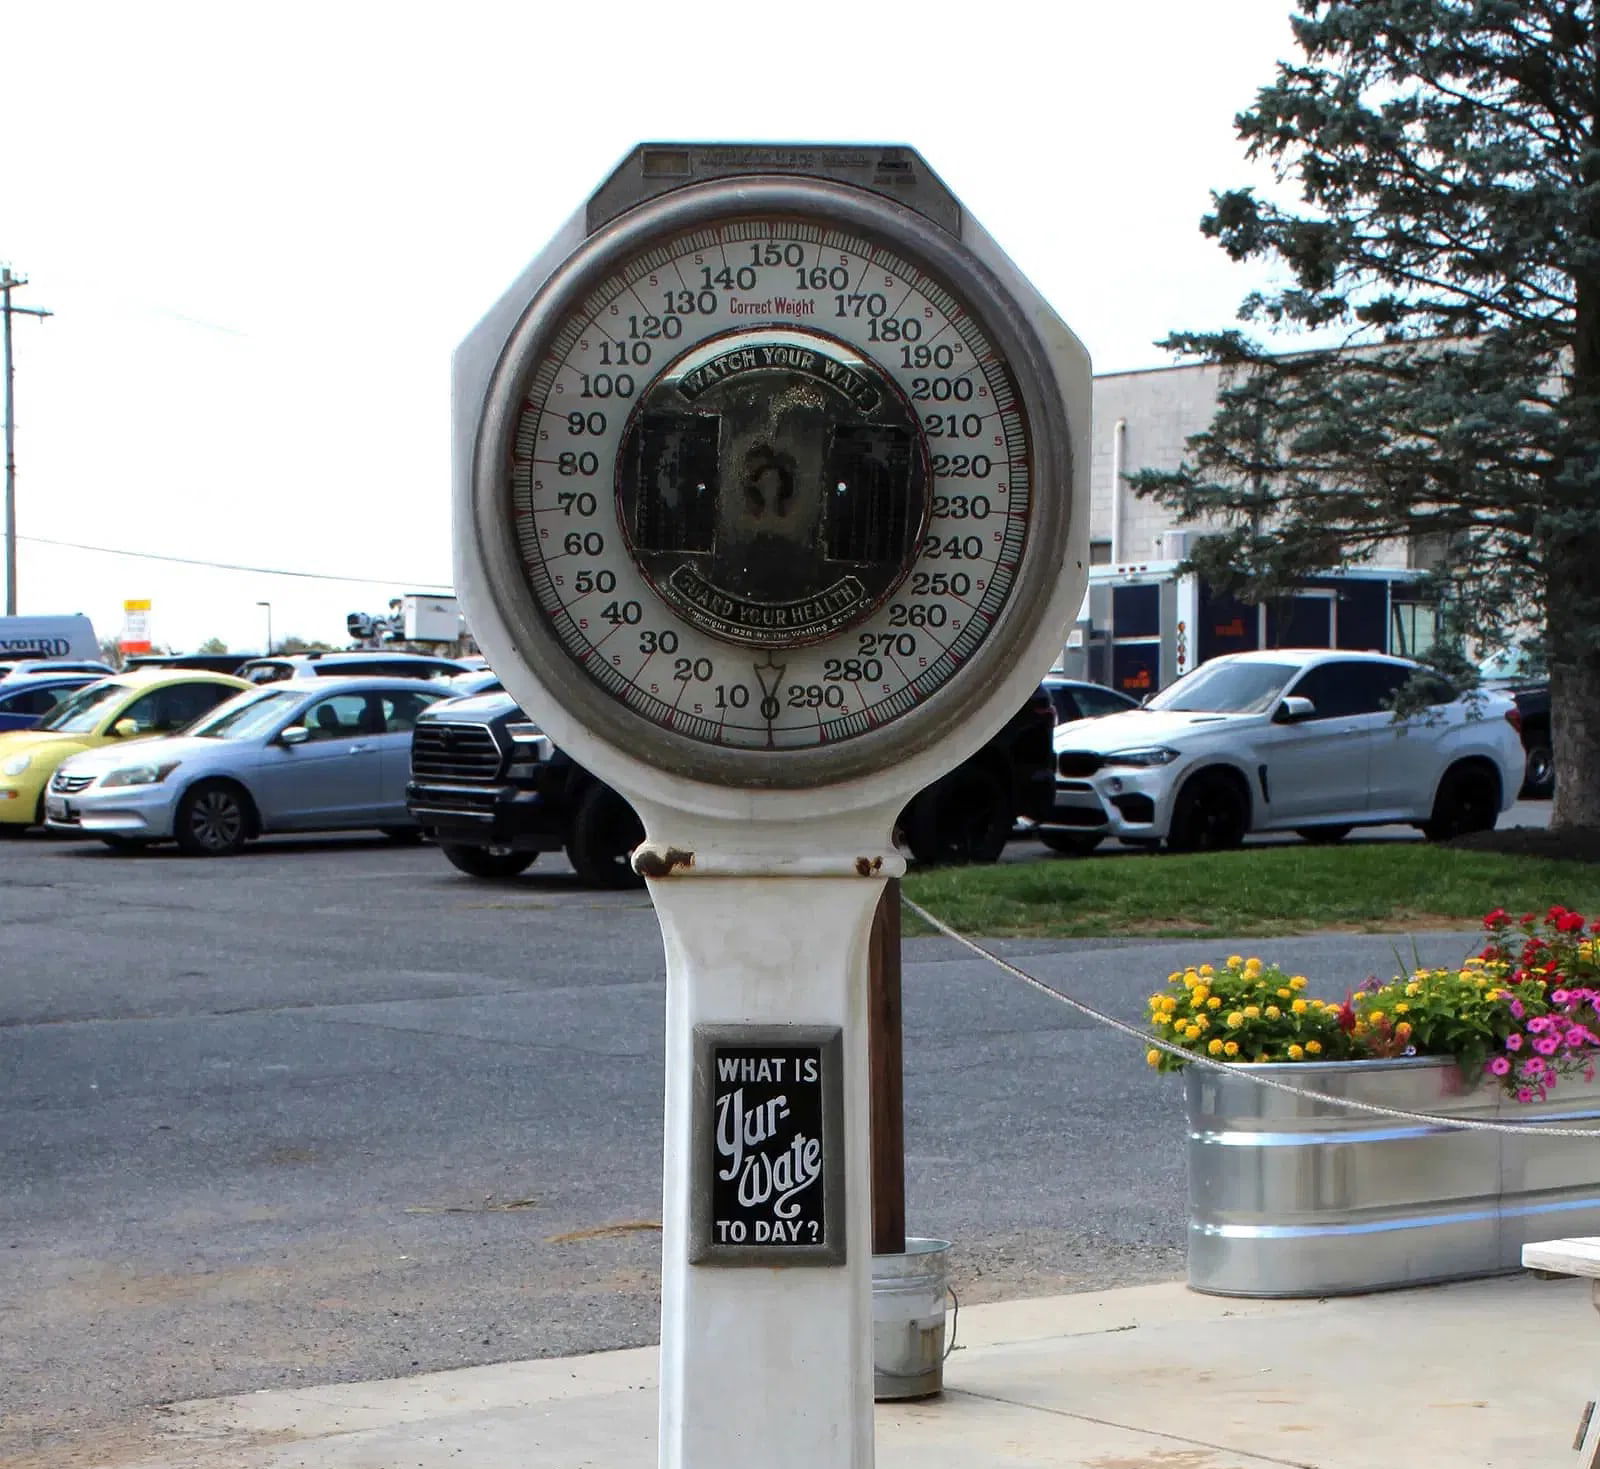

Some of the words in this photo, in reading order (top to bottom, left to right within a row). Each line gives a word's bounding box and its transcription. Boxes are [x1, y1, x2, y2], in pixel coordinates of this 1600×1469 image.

[694, 254, 704, 265] 5
[751, 243, 804, 267] 150
[839, 255, 849, 266] 5
[649, 275, 659, 287] 5
[700, 267, 756, 290] 140
[796, 267, 849, 291] 160
[884, 276, 894, 288] 5
[609, 304, 620, 316] 5
[663, 291, 717, 315] 130
[730, 297, 771, 314] Correct
[774, 298, 815, 317] Weight
[835, 293, 887, 318] 170
[924, 307, 934, 318] 5
[628, 315, 682, 339] 120
[867, 318, 922, 342] 180
[580, 339, 589, 351] 5
[599, 341, 652, 365] 110
[900, 344, 954, 369] 190
[954, 343, 964, 354] 5
[684, 349, 757, 393] WATCH
[762, 347, 817, 369] YOUR
[555, 384, 564, 394] 5
[580, 373, 635, 398] 100
[912, 377, 973, 401] 200
[978, 386, 988, 397] 5
[539, 430, 549, 441] 5
[567, 411, 607, 436] 90
[925, 414, 982, 438] 210
[994, 435, 1003, 446] 5
[558, 451, 599, 476] 80
[932, 454, 992, 478] 220
[534, 480, 544, 490] 5
[997, 482, 1007, 494] 5
[557, 492, 597, 517] 70
[932, 495, 990, 519] 230
[540, 528, 549, 539] 5
[564, 532, 604, 556] 60
[993, 531, 1003, 542] 5
[922, 535, 983, 560] 240
[555, 575, 564, 586] 5
[575, 569, 616, 593] 50
[911, 572, 970, 596] 250
[976, 579, 986, 590] 5
[600, 600, 642, 625] 40
[740, 606, 787, 625] YOUR
[792, 583, 858, 624] HEALTH
[889, 603, 947, 627] 260
[579, 618, 589, 630] 5
[952, 620, 961, 630] 5
[639, 630, 679, 654] 30
[858, 632, 916, 656] 270
[612, 655, 622, 666] 5
[673, 658, 713, 682] 20
[823, 658, 883, 682] 280
[918, 657, 928, 668] 5
[650, 683, 659, 694] 5
[714, 684, 749, 708] 10
[787, 684, 844, 708] 290
[882, 684, 891, 695] 5
[694, 703, 704, 714] 5
[760, 695, 780, 720] 0
[840, 705, 849, 716] 5
[717, 1058, 785, 1083] WHAT
[795, 1058, 818, 1083] IS
[738, 1132, 822, 1219] Wate
[716, 1221, 747, 1243] TO
